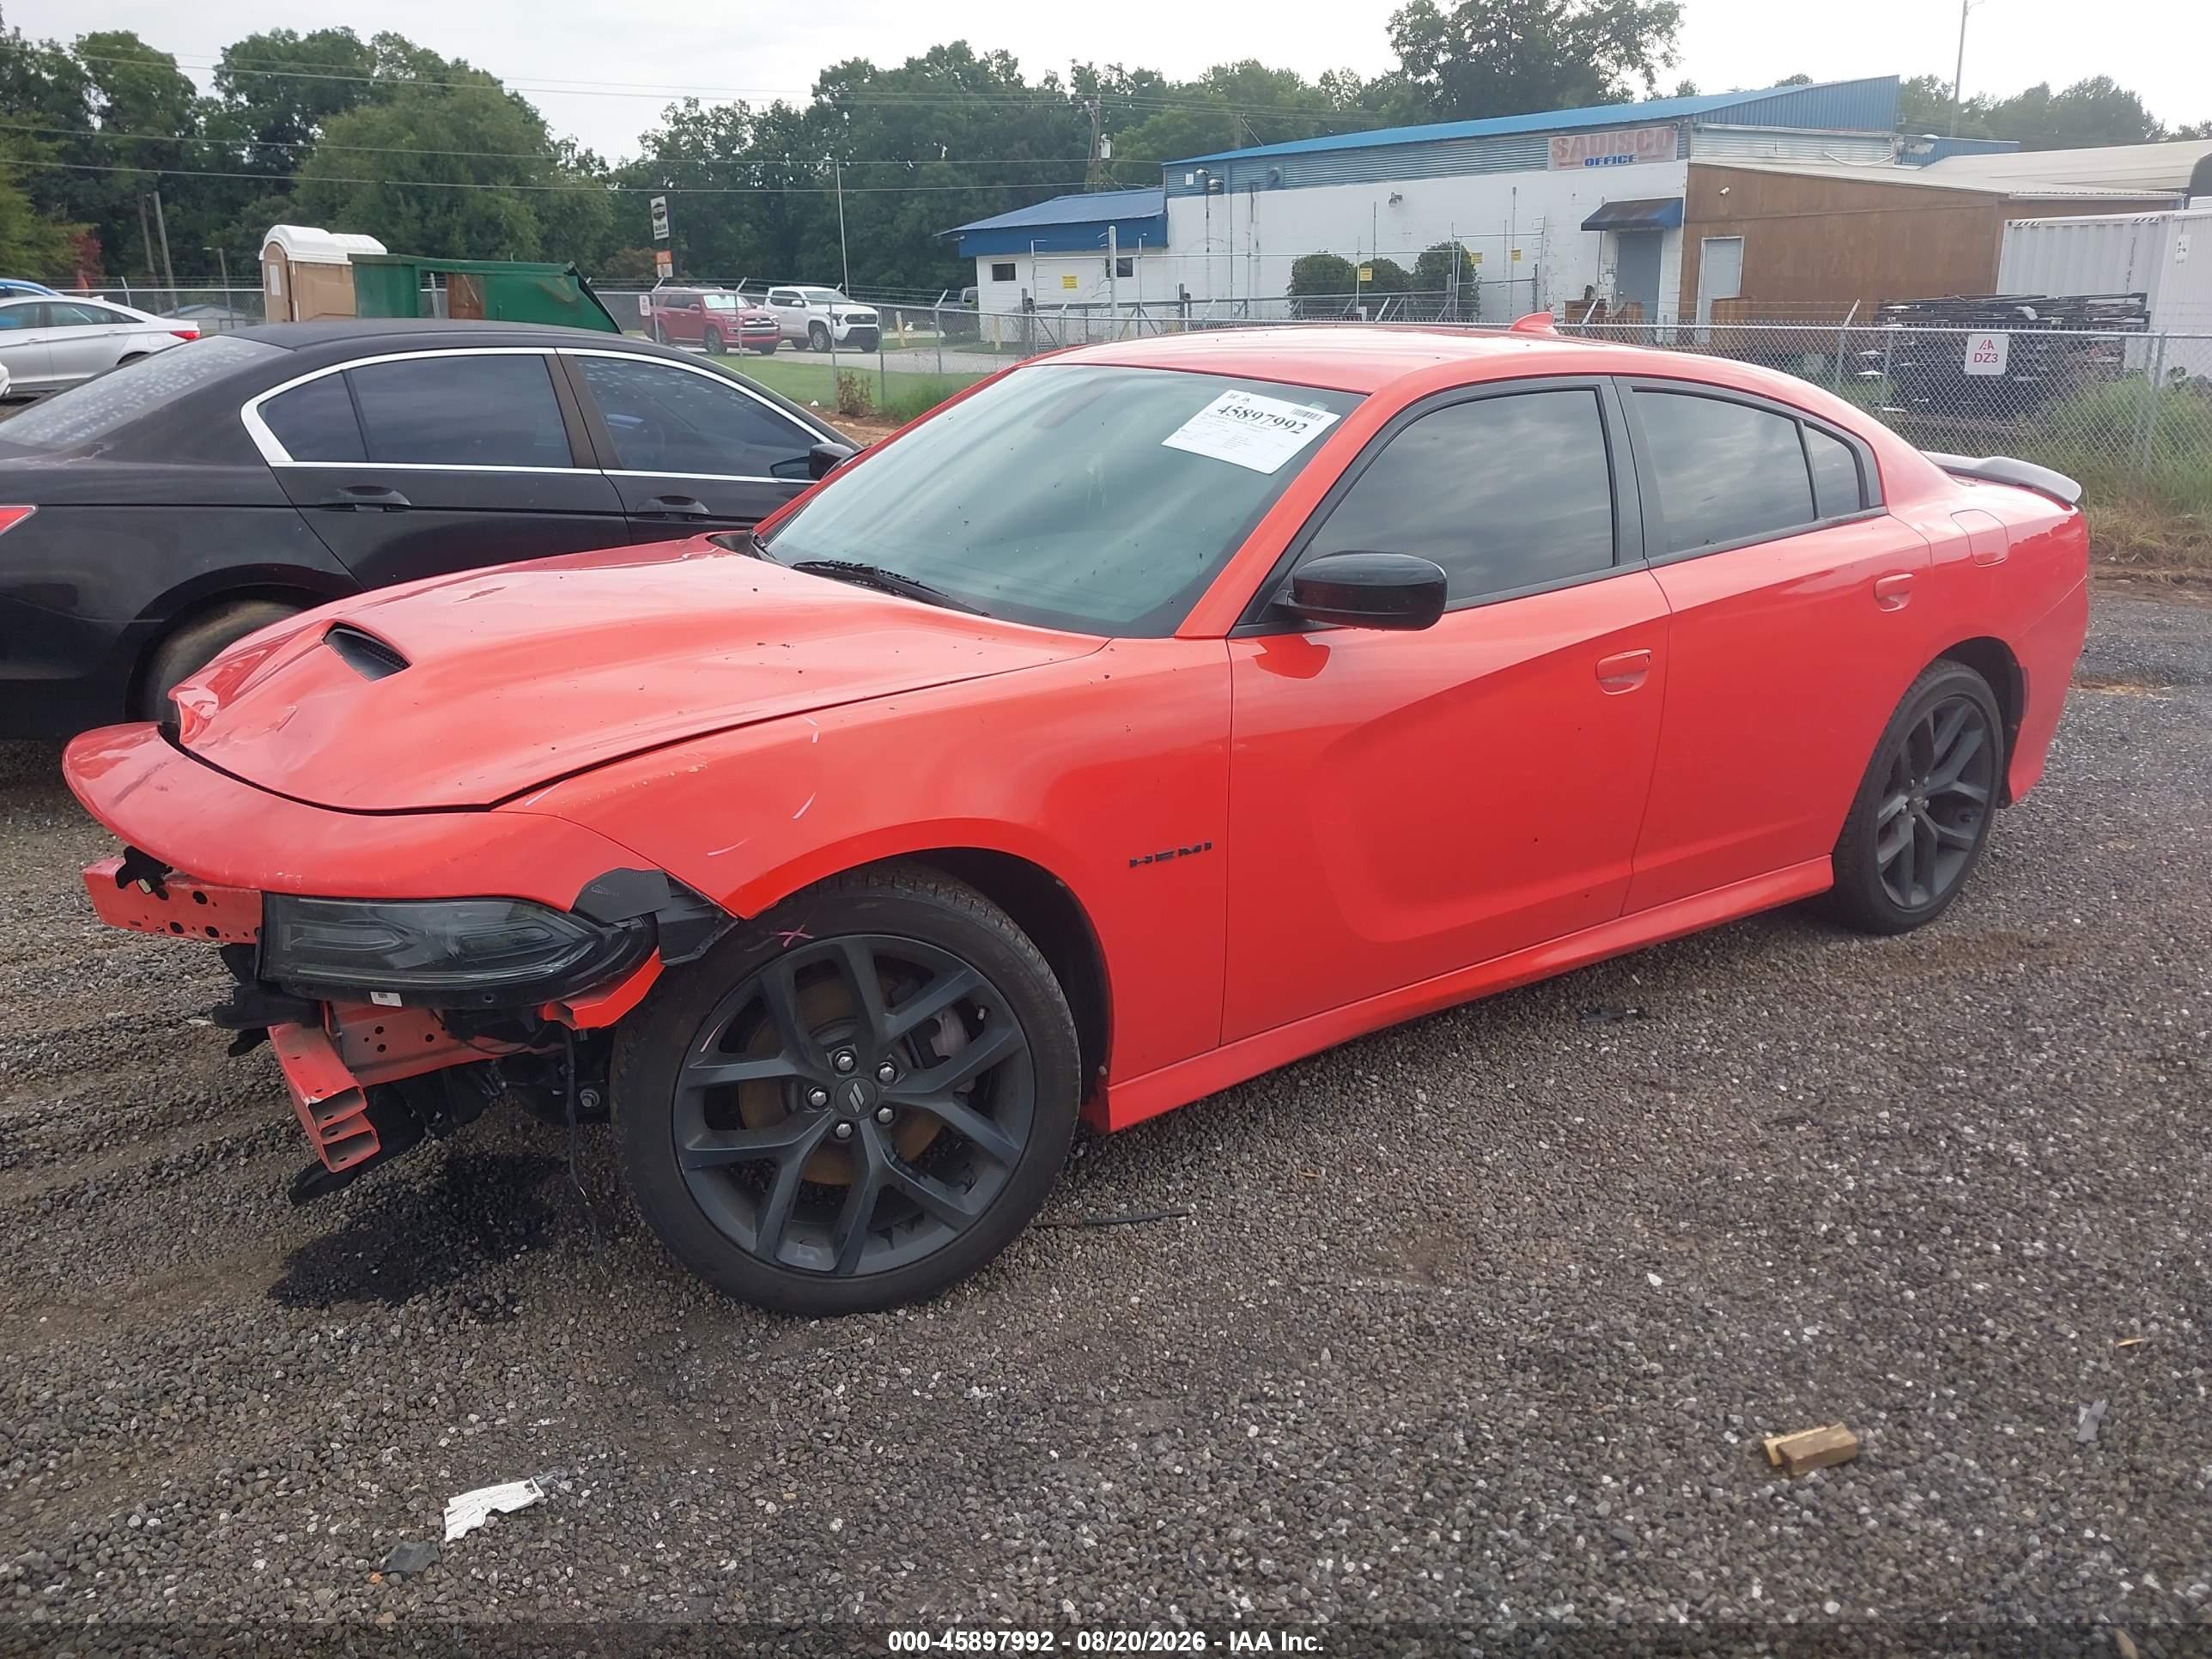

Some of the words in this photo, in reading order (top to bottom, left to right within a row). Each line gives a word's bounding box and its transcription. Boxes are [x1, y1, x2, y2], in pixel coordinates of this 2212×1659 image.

[1552, 129, 1675, 158] SADISCO
[1584, 154, 1637, 167] OFFICE
[1973, 352, 1999, 363] DZ3
[1217, 404, 1309, 434] 45897992
[1129, 842, 1212, 868] HEMI
